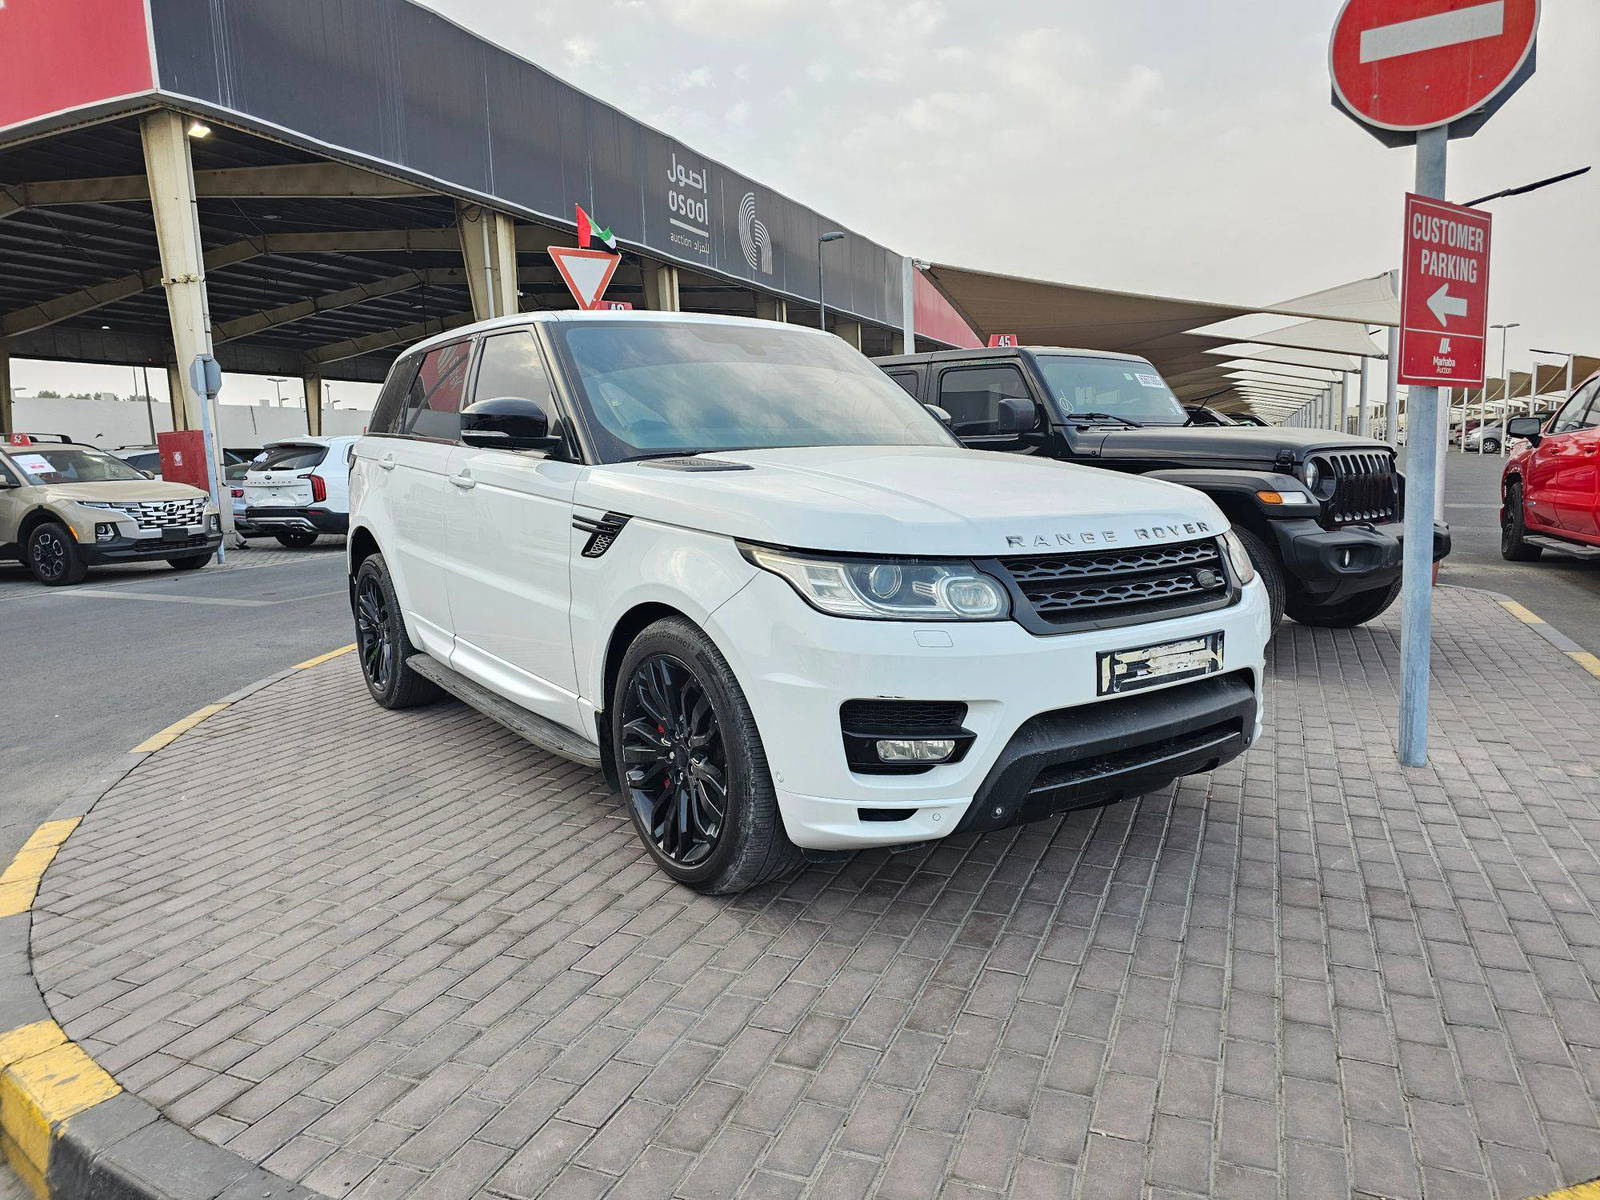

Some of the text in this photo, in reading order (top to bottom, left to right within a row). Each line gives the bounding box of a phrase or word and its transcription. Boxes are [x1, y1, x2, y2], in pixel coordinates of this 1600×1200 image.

[670, 232, 692, 248] auction
[1412, 212, 1485, 253] CUSTOMER
[1420, 248, 1478, 284] PARKING
[997, 335, 1012, 348] 45
[1006, 521, 1211, 548] RANGE ROVER
